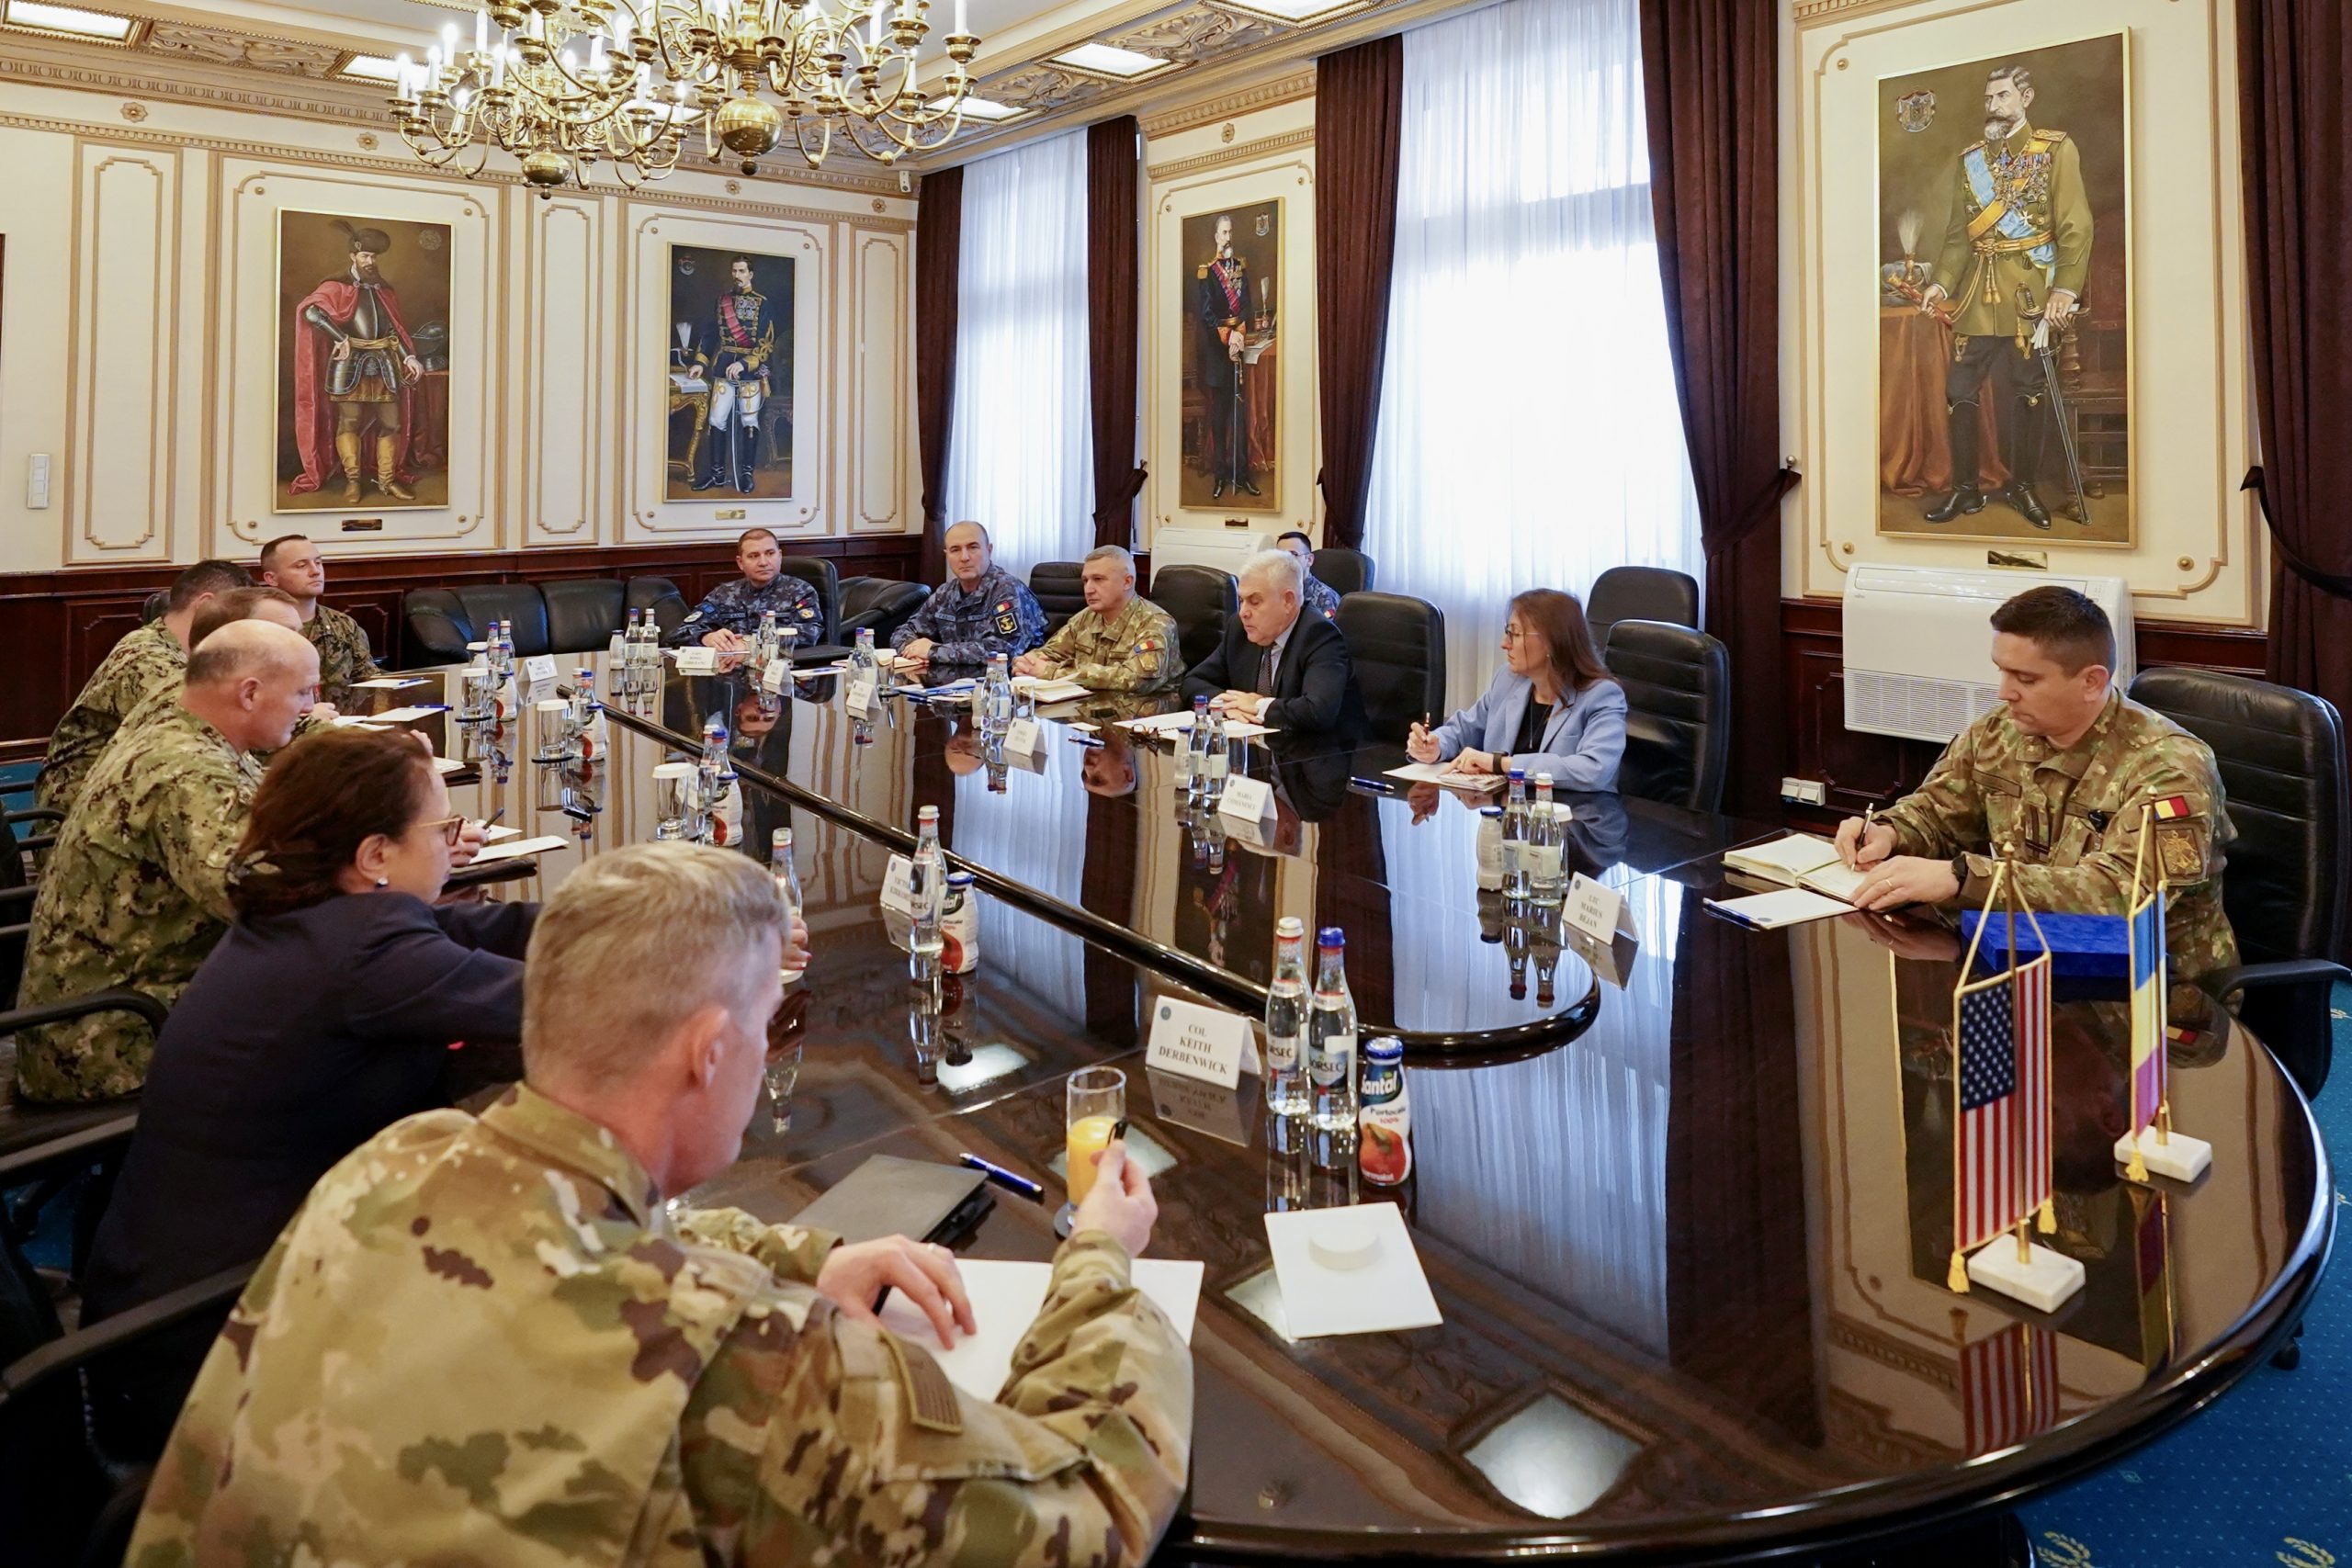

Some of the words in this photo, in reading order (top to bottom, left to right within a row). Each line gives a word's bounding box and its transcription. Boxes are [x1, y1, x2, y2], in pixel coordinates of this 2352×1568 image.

[1188, 1024, 1206, 1037] COL
[1180, 1036, 1212, 1054] KEITH
[1159, 1045, 1228, 1075] DERBENWICK
